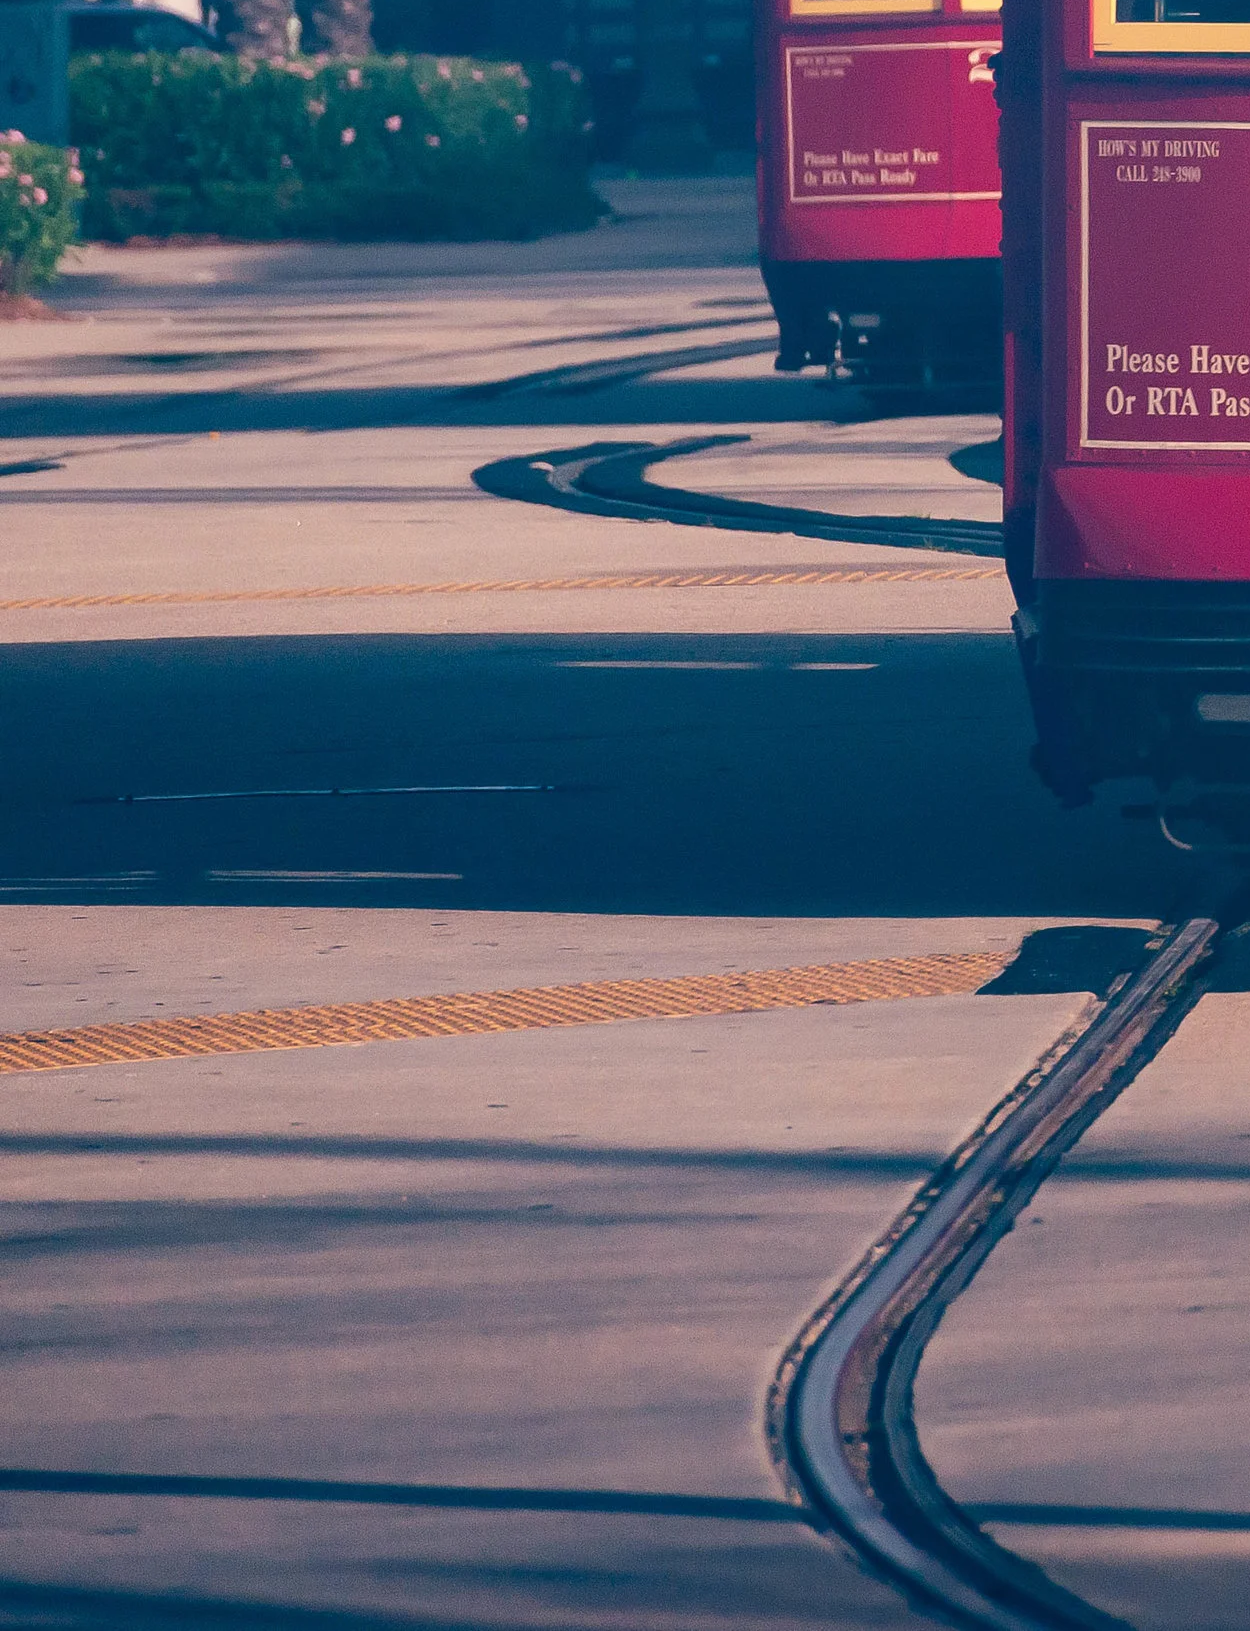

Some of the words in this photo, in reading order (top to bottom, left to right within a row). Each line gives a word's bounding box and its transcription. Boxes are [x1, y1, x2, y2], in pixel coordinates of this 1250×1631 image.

[1098, 139, 1137, 157] HOW'S
[1140, 140, 1160, 157] MY
[1164, 140, 1220, 158] DRIVING
[1116, 164, 1148, 182] CALL
[1106, 344, 1180, 373] Please
[1190, 344, 1250, 374] Have
[1105, 385, 1136, 415] Or
[1147, 387, 1200, 416] RTA
